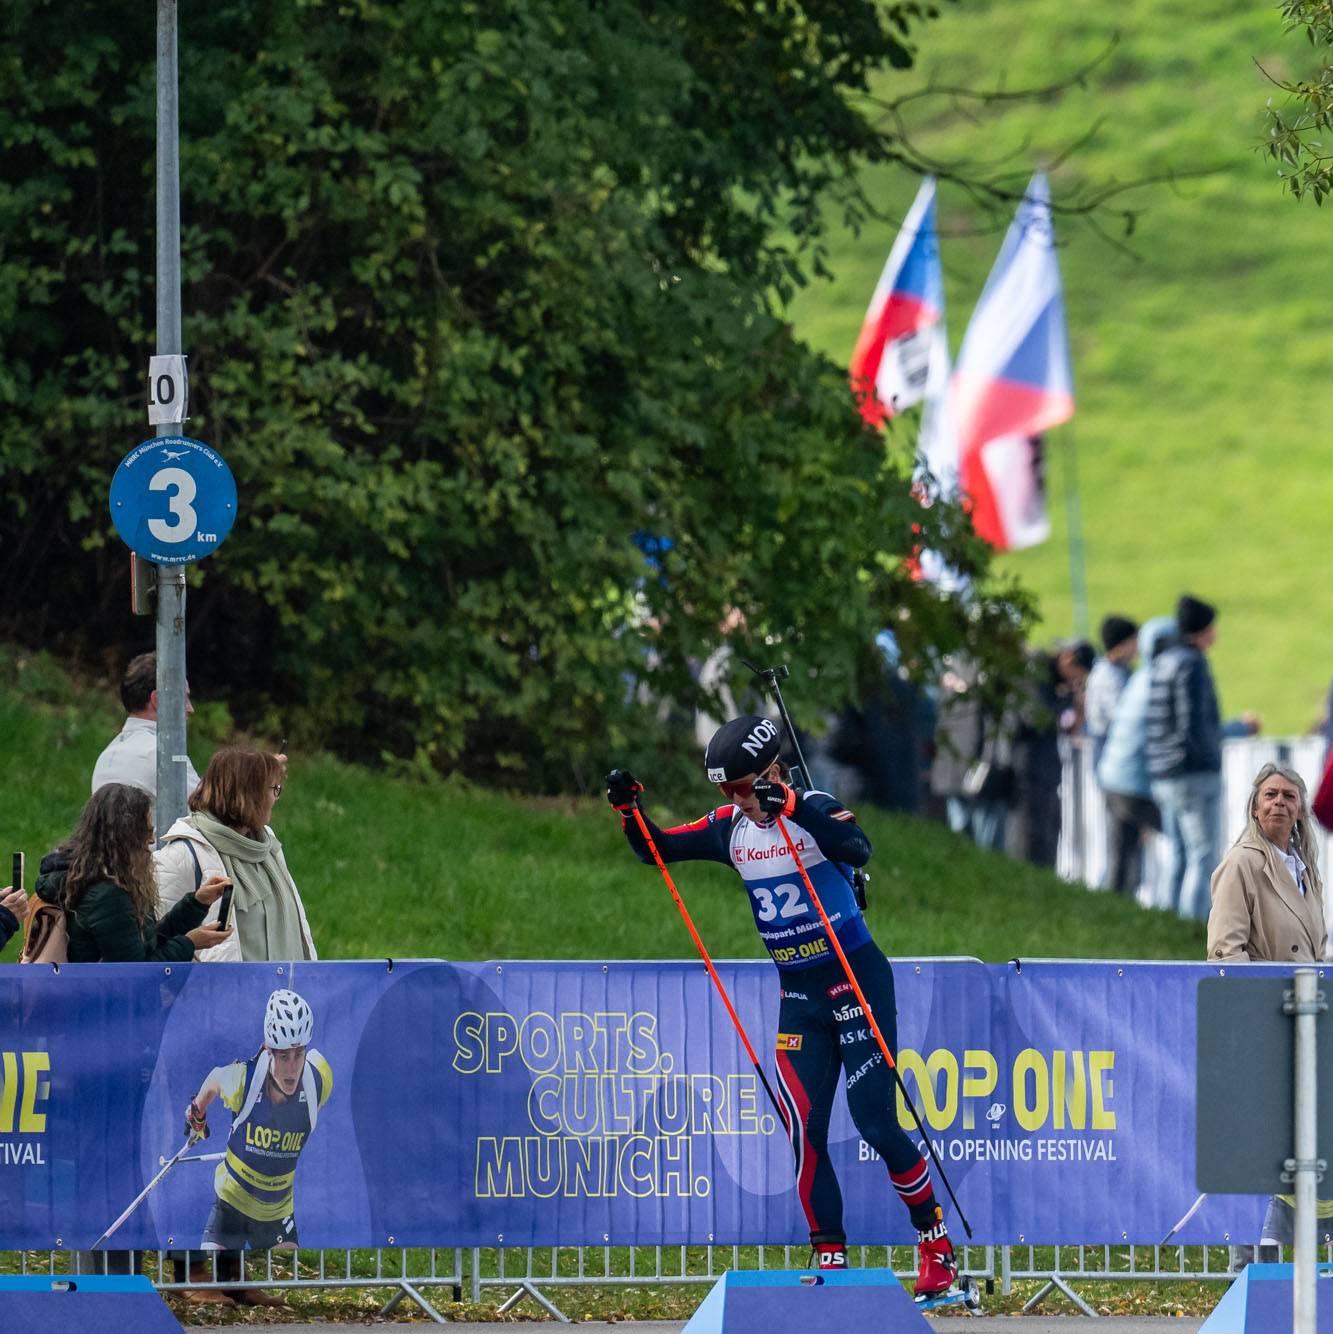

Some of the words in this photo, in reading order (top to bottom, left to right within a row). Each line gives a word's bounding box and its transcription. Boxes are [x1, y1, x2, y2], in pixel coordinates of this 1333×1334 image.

[148, 467, 198, 544] 3
[197, 531, 217, 543] km
[752, 883, 809, 922] 32
[796, 911, 841, 934] Müncen
[784, 991, 808, 1001] LAPUA
[452, 1012, 674, 1074] SPORTS.
[847, 1058, 874, 1089] CRAFT
[896, 1048, 998, 1132] OOP
[1012, 1048, 1117, 1132] ONE
[527, 1073, 775, 1136] CULTURE.
[475, 1135, 711, 1198] MUNICH.
[949, 1139, 1032, 1161] OPENING
[1037, 1139, 1117, 1161] FESTIVAL
[820, 1251, 845, 1265] DS
